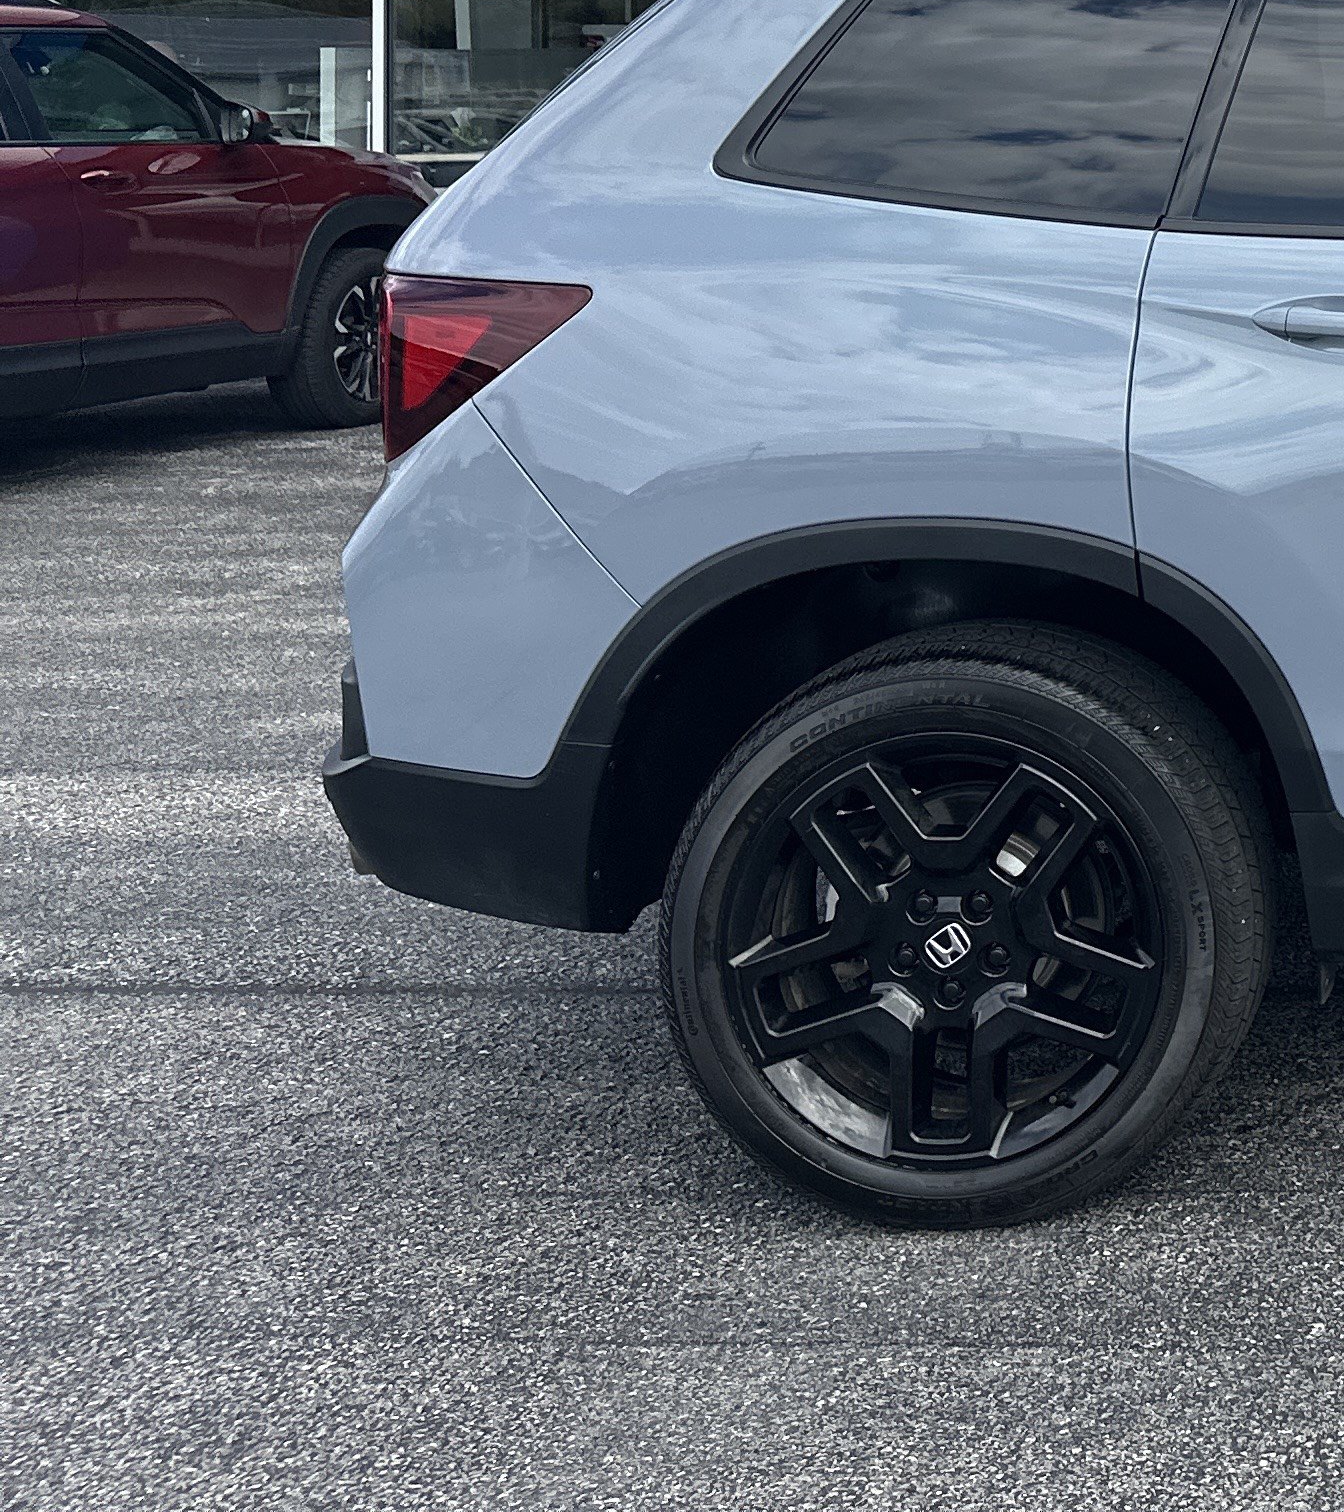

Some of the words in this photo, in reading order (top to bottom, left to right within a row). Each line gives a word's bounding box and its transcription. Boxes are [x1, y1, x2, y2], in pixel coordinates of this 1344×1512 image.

[789, 690, 989, 754] CONTINNTAL
[1189, 890, 1204, 916] LX
[1197, 916, 1207, 952] SPORT
